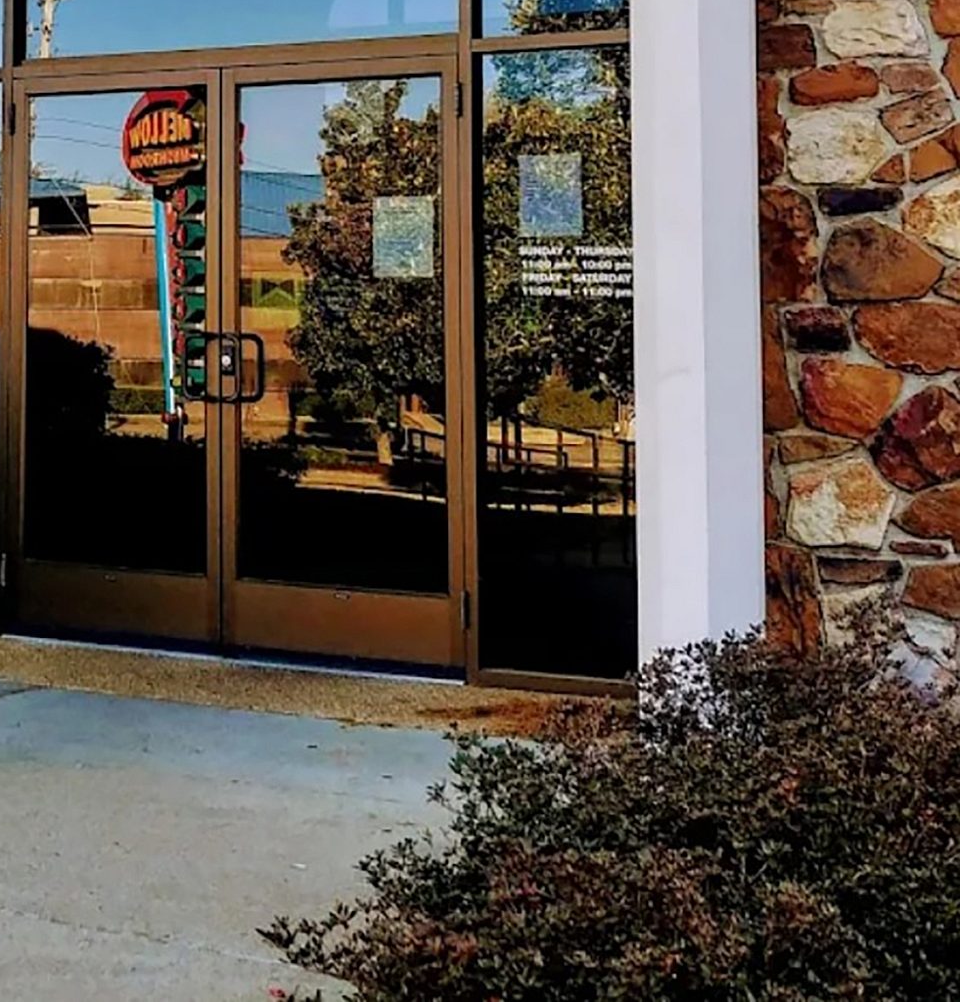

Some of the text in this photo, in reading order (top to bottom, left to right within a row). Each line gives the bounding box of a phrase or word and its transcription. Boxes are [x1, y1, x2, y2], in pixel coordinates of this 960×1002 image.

[519, 246, 563, 256] SUNDAY
[582, 260, 612, 269] 10:00
[522, 273, 562, 283] FRIDAY
[573, 273, 632, 284] SATURDAY
[522, 286, 551, 296] 11:00
[582, 287, 613, 297] 11:00
